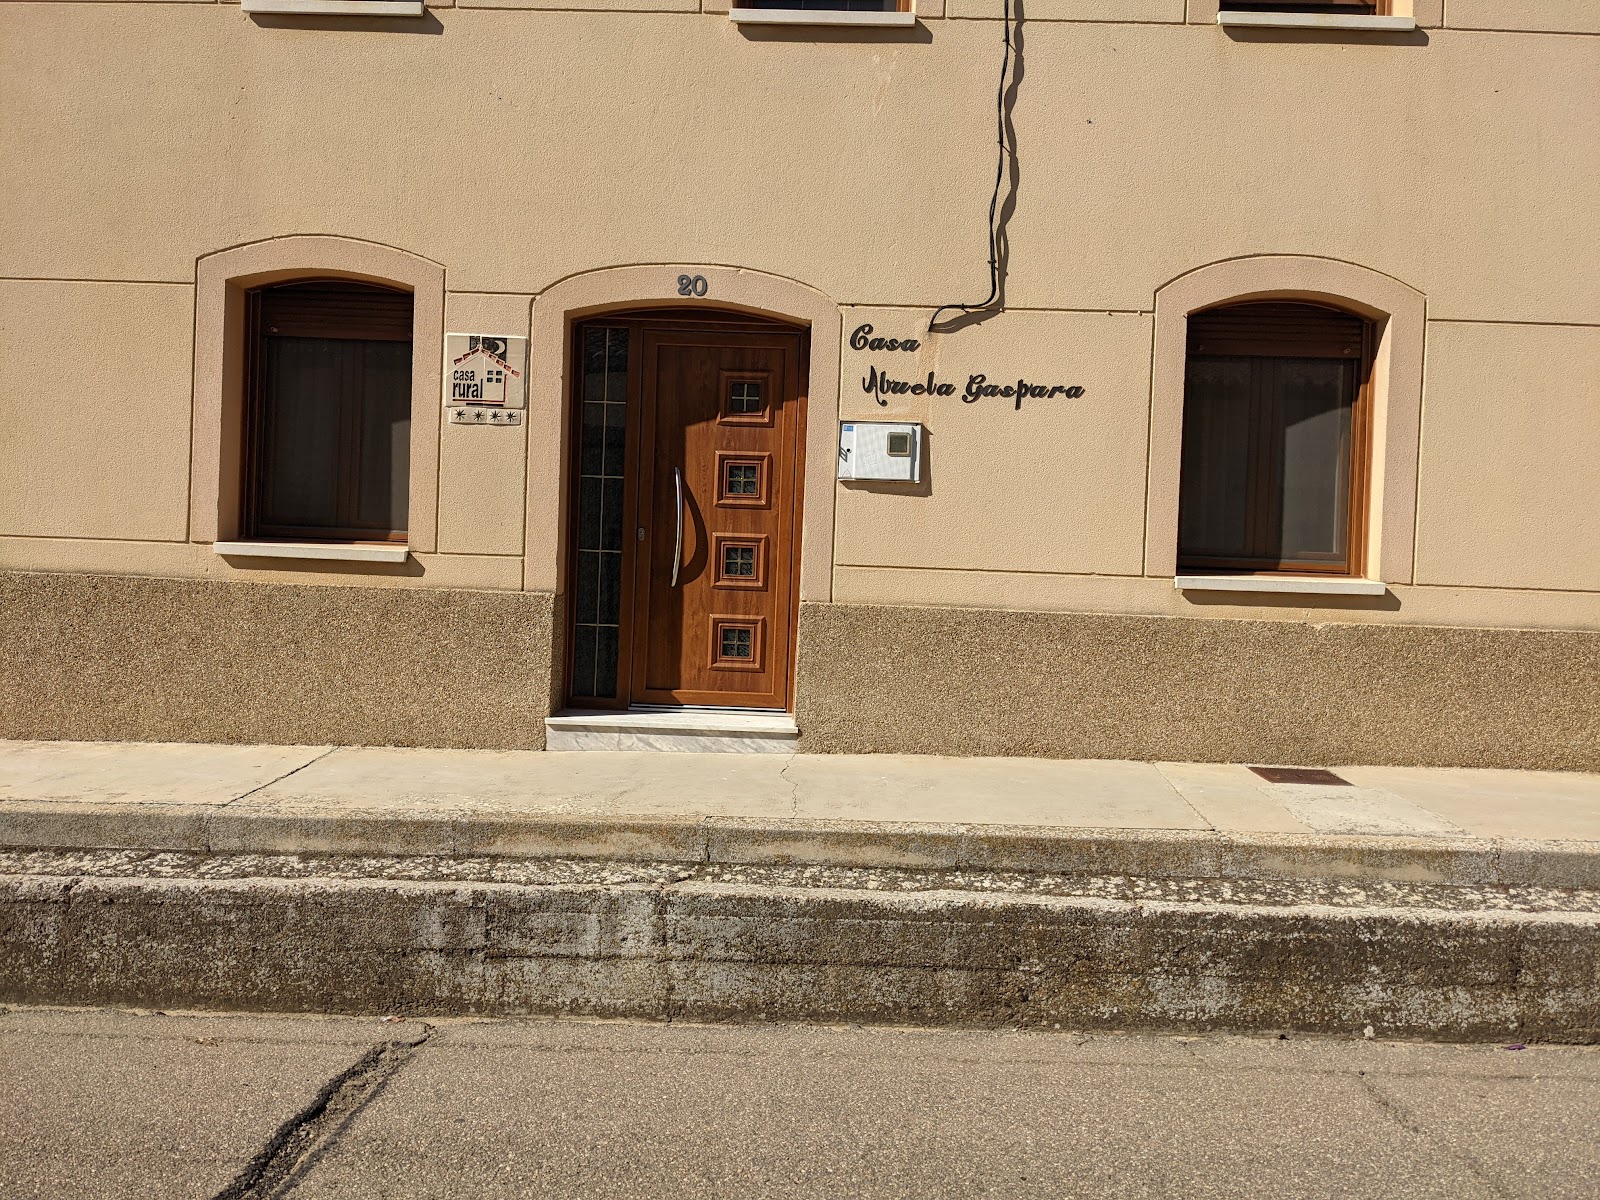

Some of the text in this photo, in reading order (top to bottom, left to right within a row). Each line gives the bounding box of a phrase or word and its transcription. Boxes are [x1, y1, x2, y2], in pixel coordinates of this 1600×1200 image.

[677, 274, 708, 297] 20
[849, 323, 921, 352] Casa
[453, 370, 475, 382] casa
[452, 378, 483, 399] rural
[862, 365, 1086, 411] Abuela Gaspara
